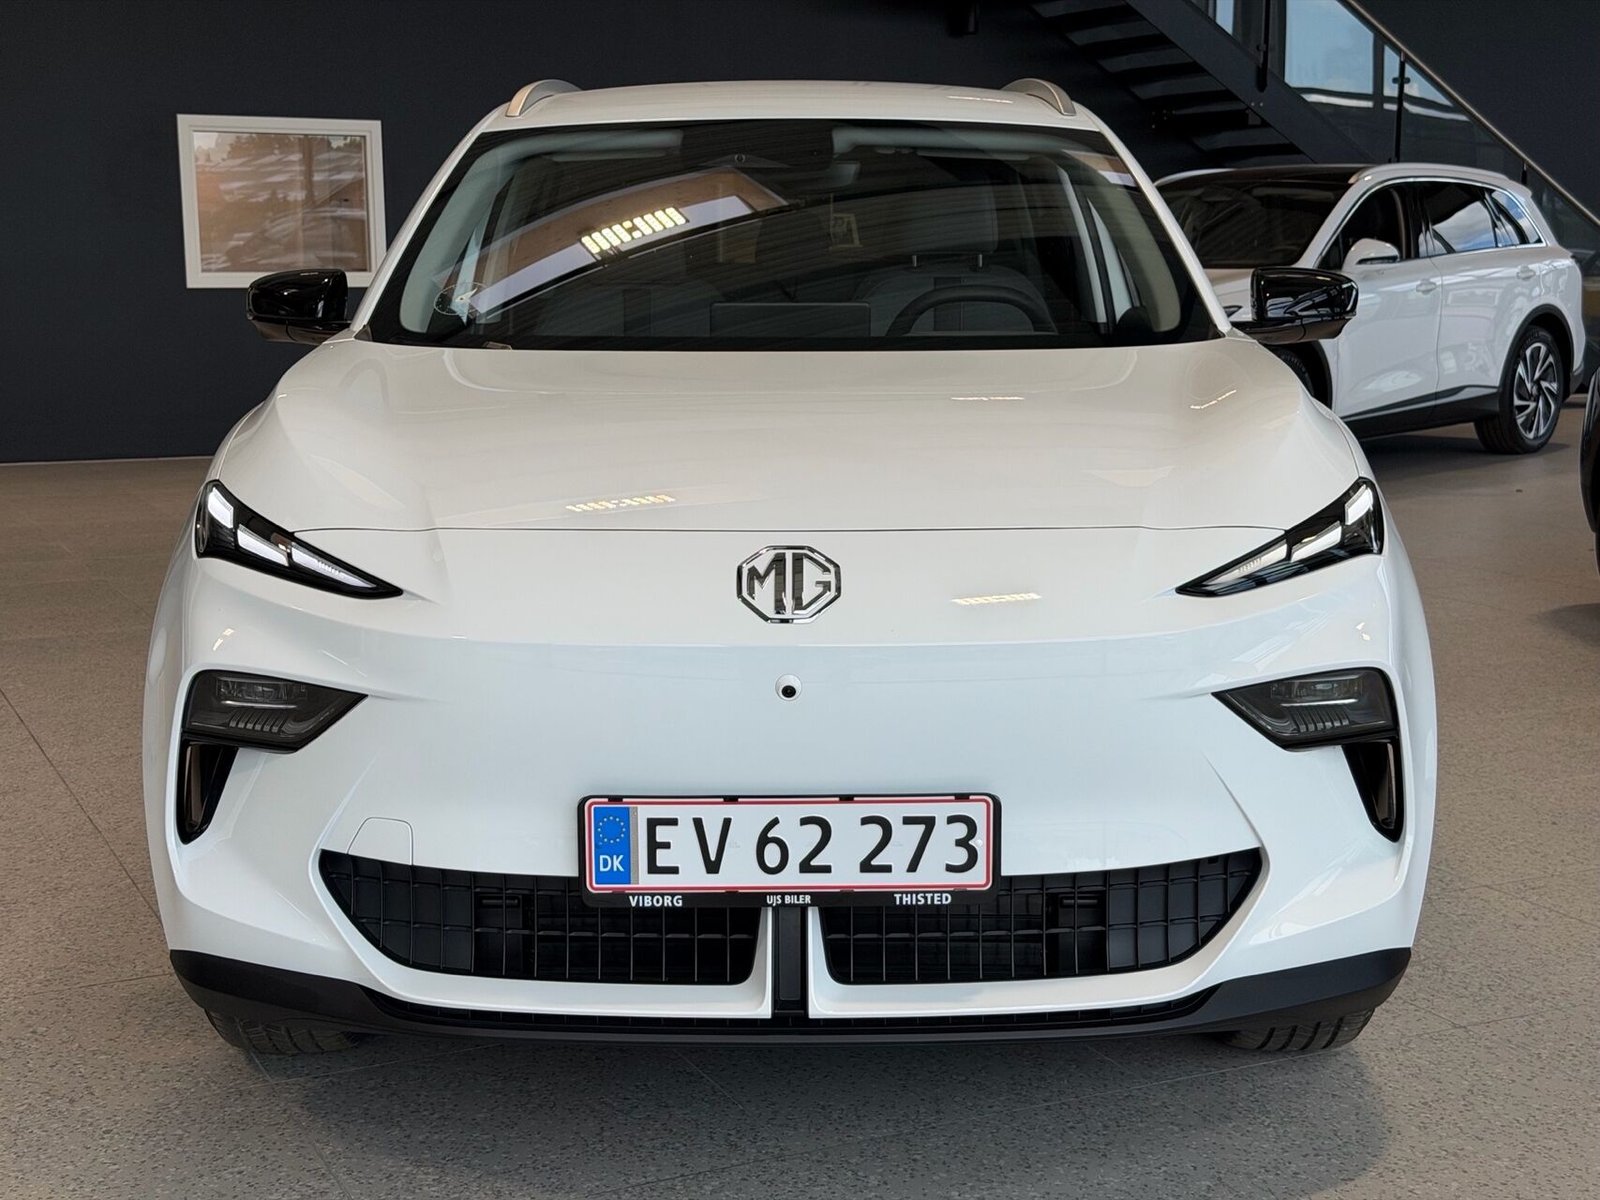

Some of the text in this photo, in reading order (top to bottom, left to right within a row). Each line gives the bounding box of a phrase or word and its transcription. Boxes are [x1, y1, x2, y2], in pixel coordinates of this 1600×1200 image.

[745, 551, 833, 615] MG
[645, 815, 979, 875] EV 62 273
[599, 854, 625, 872] DK
[628, 895, 684, 907] VIBORG
[766, 894, 812, 906] UJS BILER
[894, 893, 952, 905] THISTED
